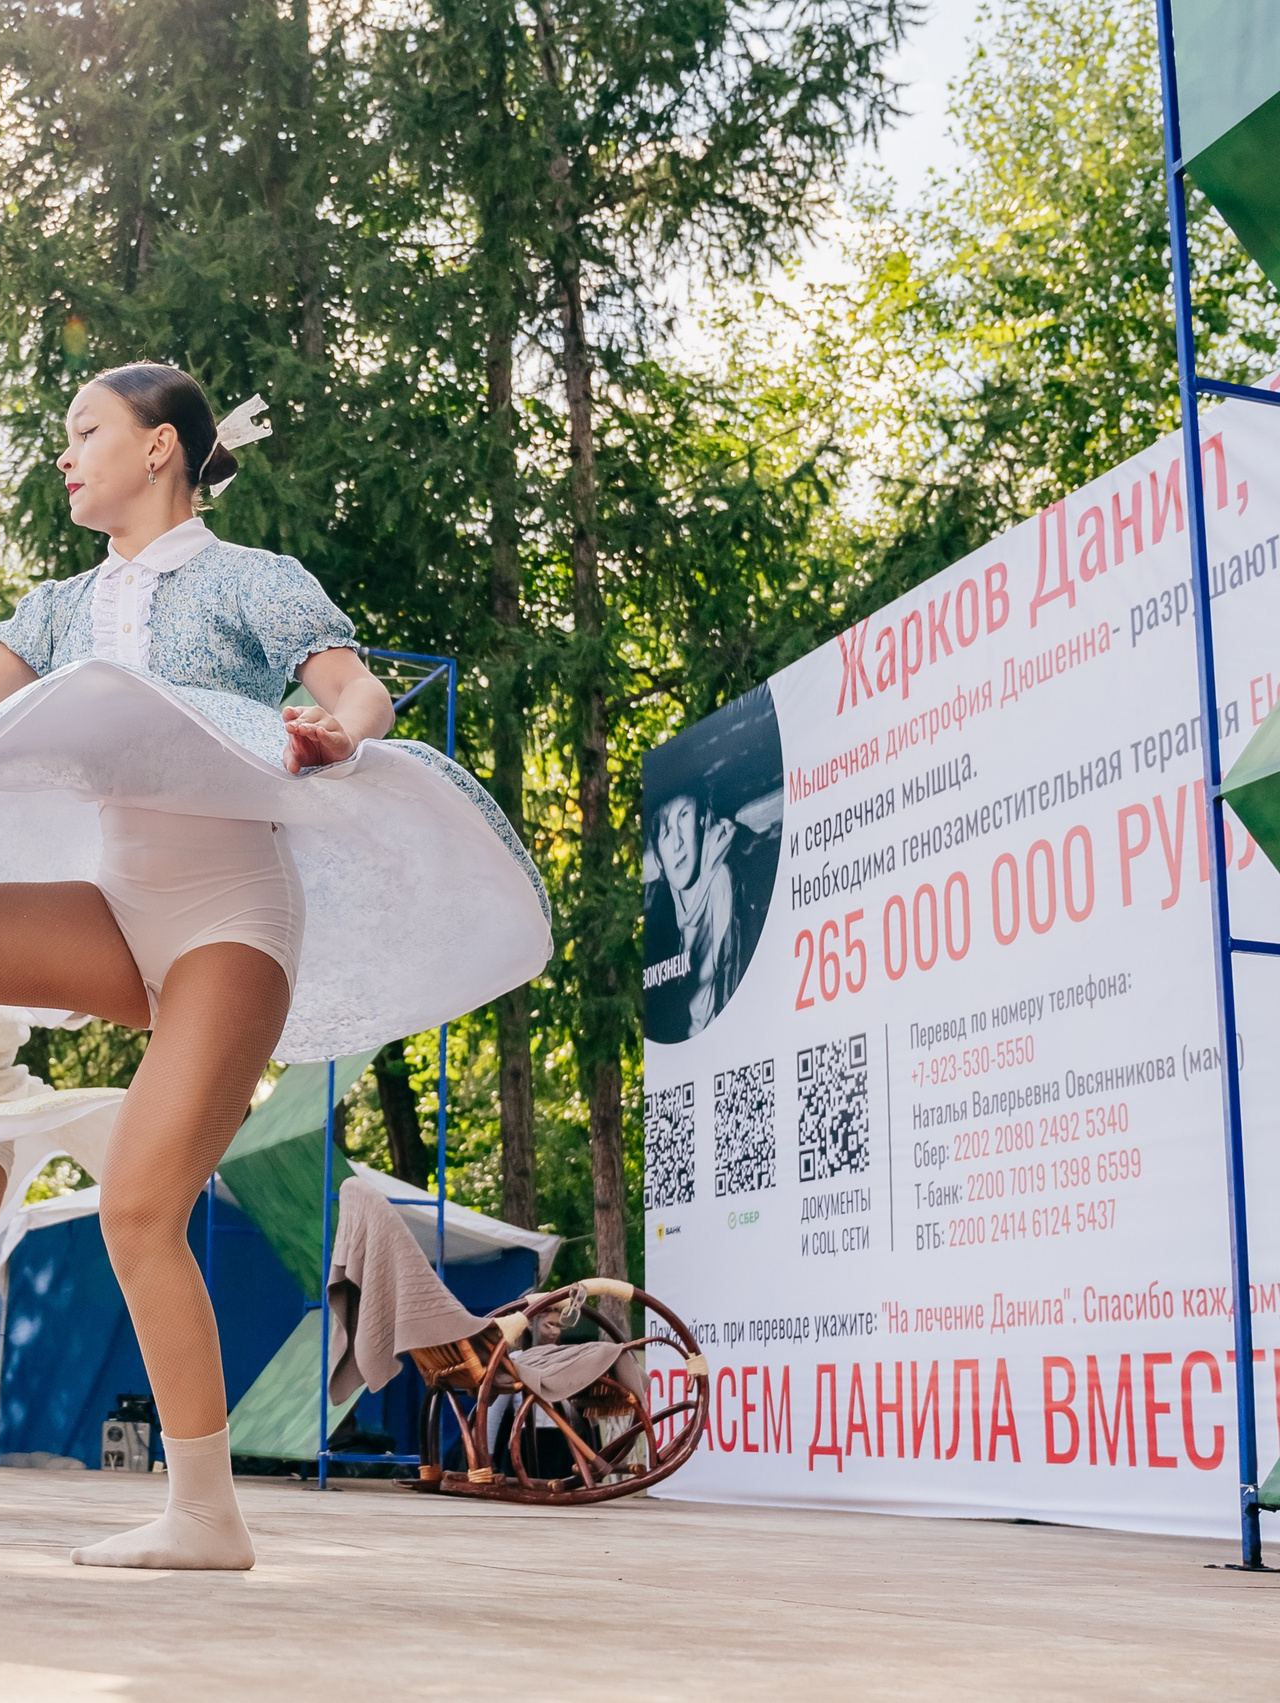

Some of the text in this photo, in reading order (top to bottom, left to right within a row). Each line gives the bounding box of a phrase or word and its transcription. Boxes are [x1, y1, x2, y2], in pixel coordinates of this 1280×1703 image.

[789, 737, 880, 804] Мышечная
[886, 680, 992, 764] дистрофия
[1130, 534, 1279, 648] разршают
[836, 562, 1010, 716] Жарков
[790, 753, 977, 859] и сердечная мышца.
[791, 845, 895, 910] Необходима
[902, 750, 1122, 867] генозаместительная
[794, 908, 867, 1011] 265
[883, 871, 971, 981] 000
[991, 824, 1095, 946] 000
[910, 972, 1132, 1051] Перевод по номеру телефона:
[911, 1035, 1035, 1088] +7-923-530-5550
[912, 1033, 1244, 1131] Наталья Валерьевна Овсянникова (мам)
[914, 1102, 1129, 1170] Сбер: 2202 2080 2492 5340
[801, 1187, 871, 1224] ДОКУМЕНТЫ
[914, 1147, 1141, 1209] Т-банк: 2200 7019 1398 6599
[738, 1211, 760, 1225] СБЕР
[801, 1226, 870, 1257] И СОЦ. СЕТИ
[916, 1198, 1116, 1250] ВТБ: 2200 2414 6124 5437
[723, 1321, 745, 1349] при
[749, 1316, 809, 1347] переводе
[814, 1311, 878, 1342] укажите:
[881, 1301, 909, 1334] "На
[914, 1303, 984, 1333] лечение
[1083, 1280, 1173, 1323] Спасибо
[808, 1357, 1021, 1473] ДАНИЛА
